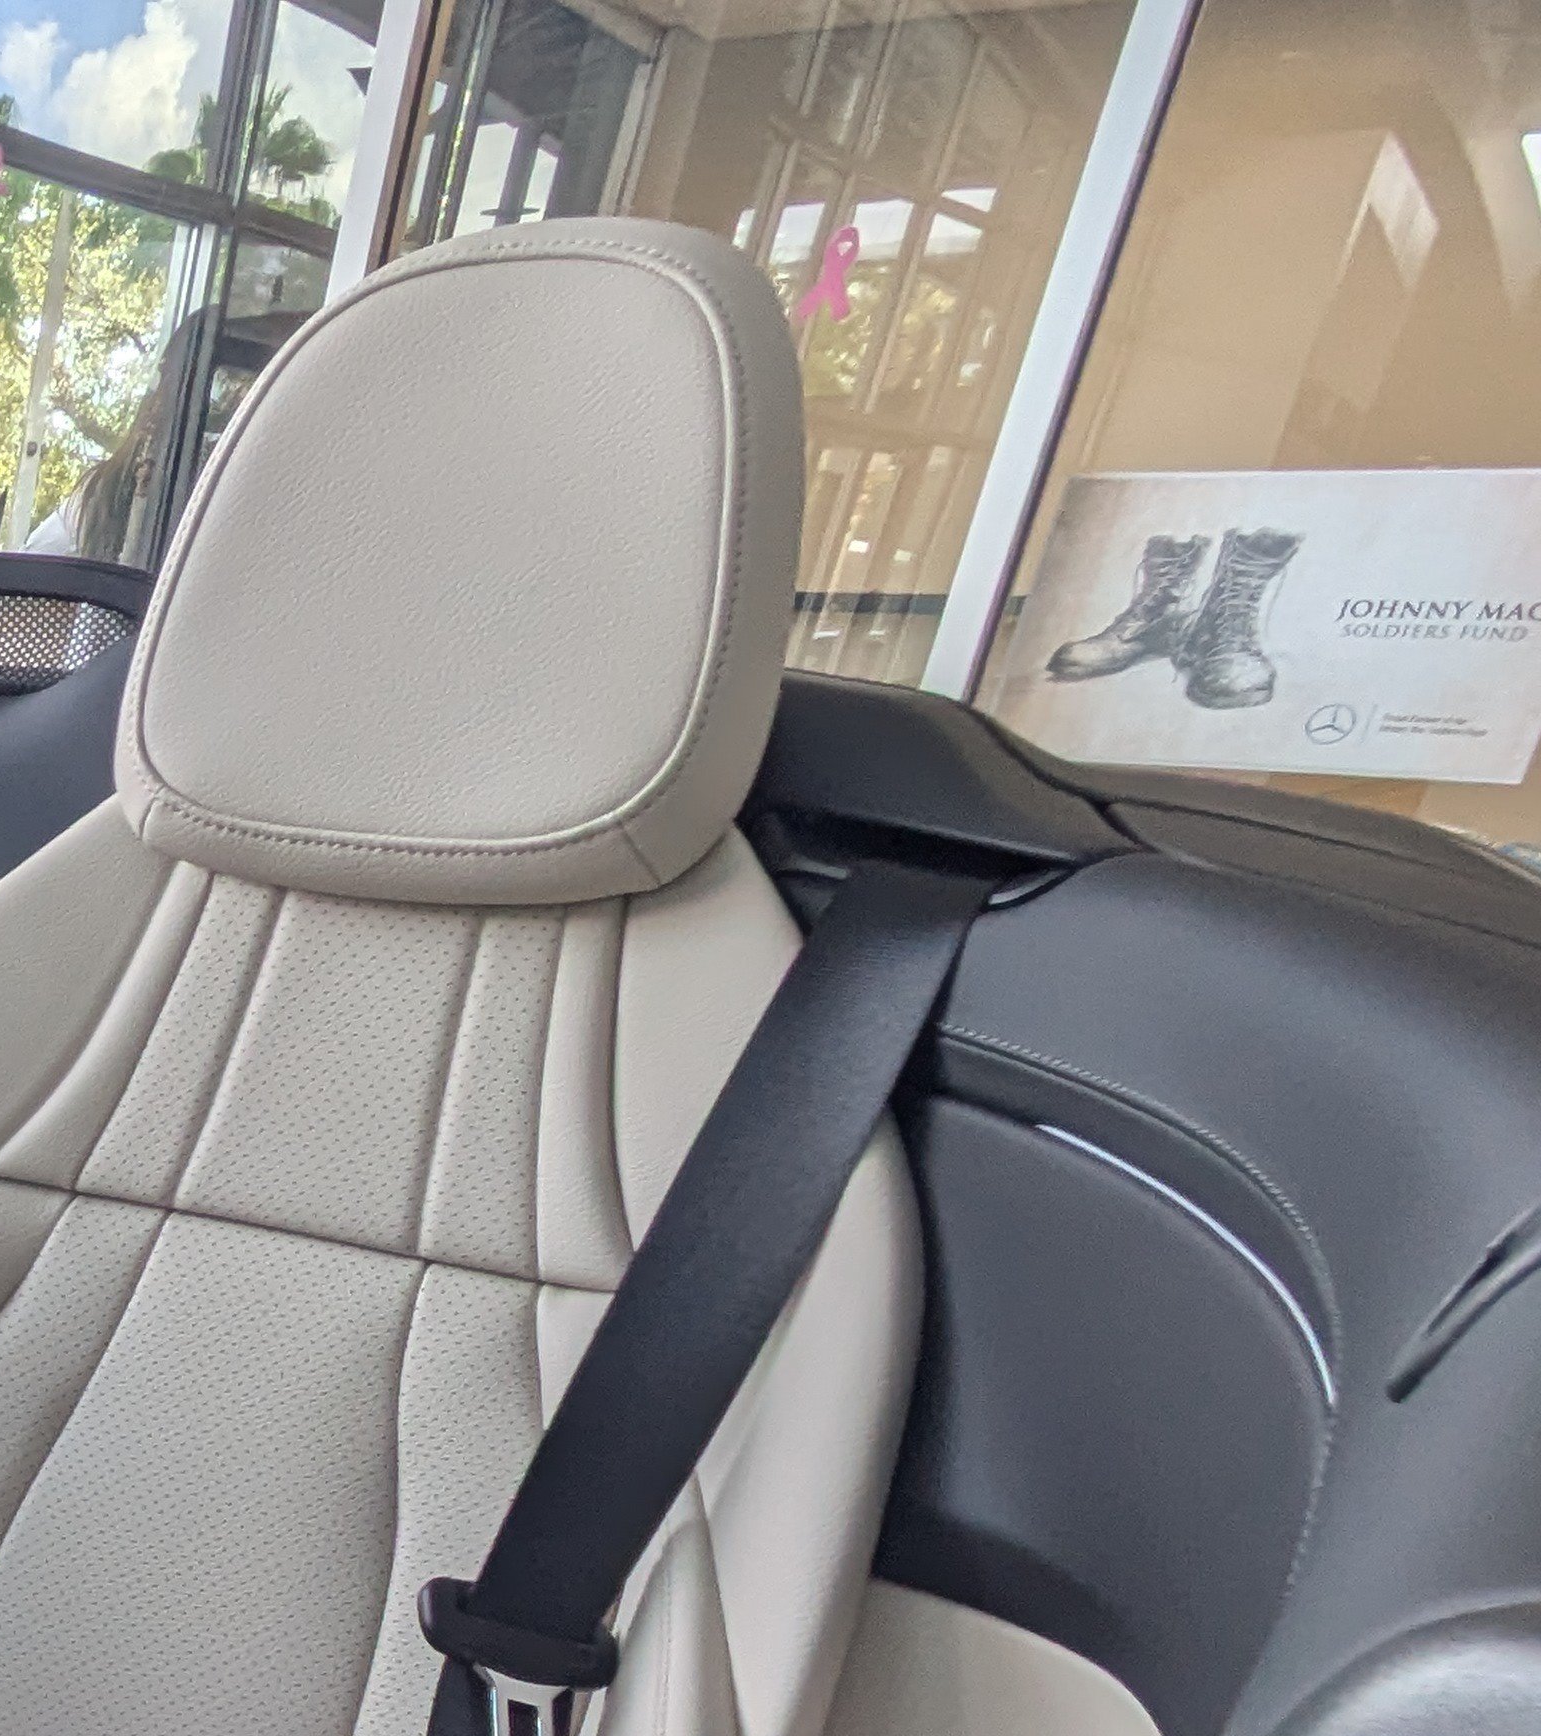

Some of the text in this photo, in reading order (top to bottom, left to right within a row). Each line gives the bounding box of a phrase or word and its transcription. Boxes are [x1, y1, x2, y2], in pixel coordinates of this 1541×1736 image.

[1335, 599, 1473, 621] JOHNNY
[1340, 622, 1529, 642] SOLDIERS FUND
